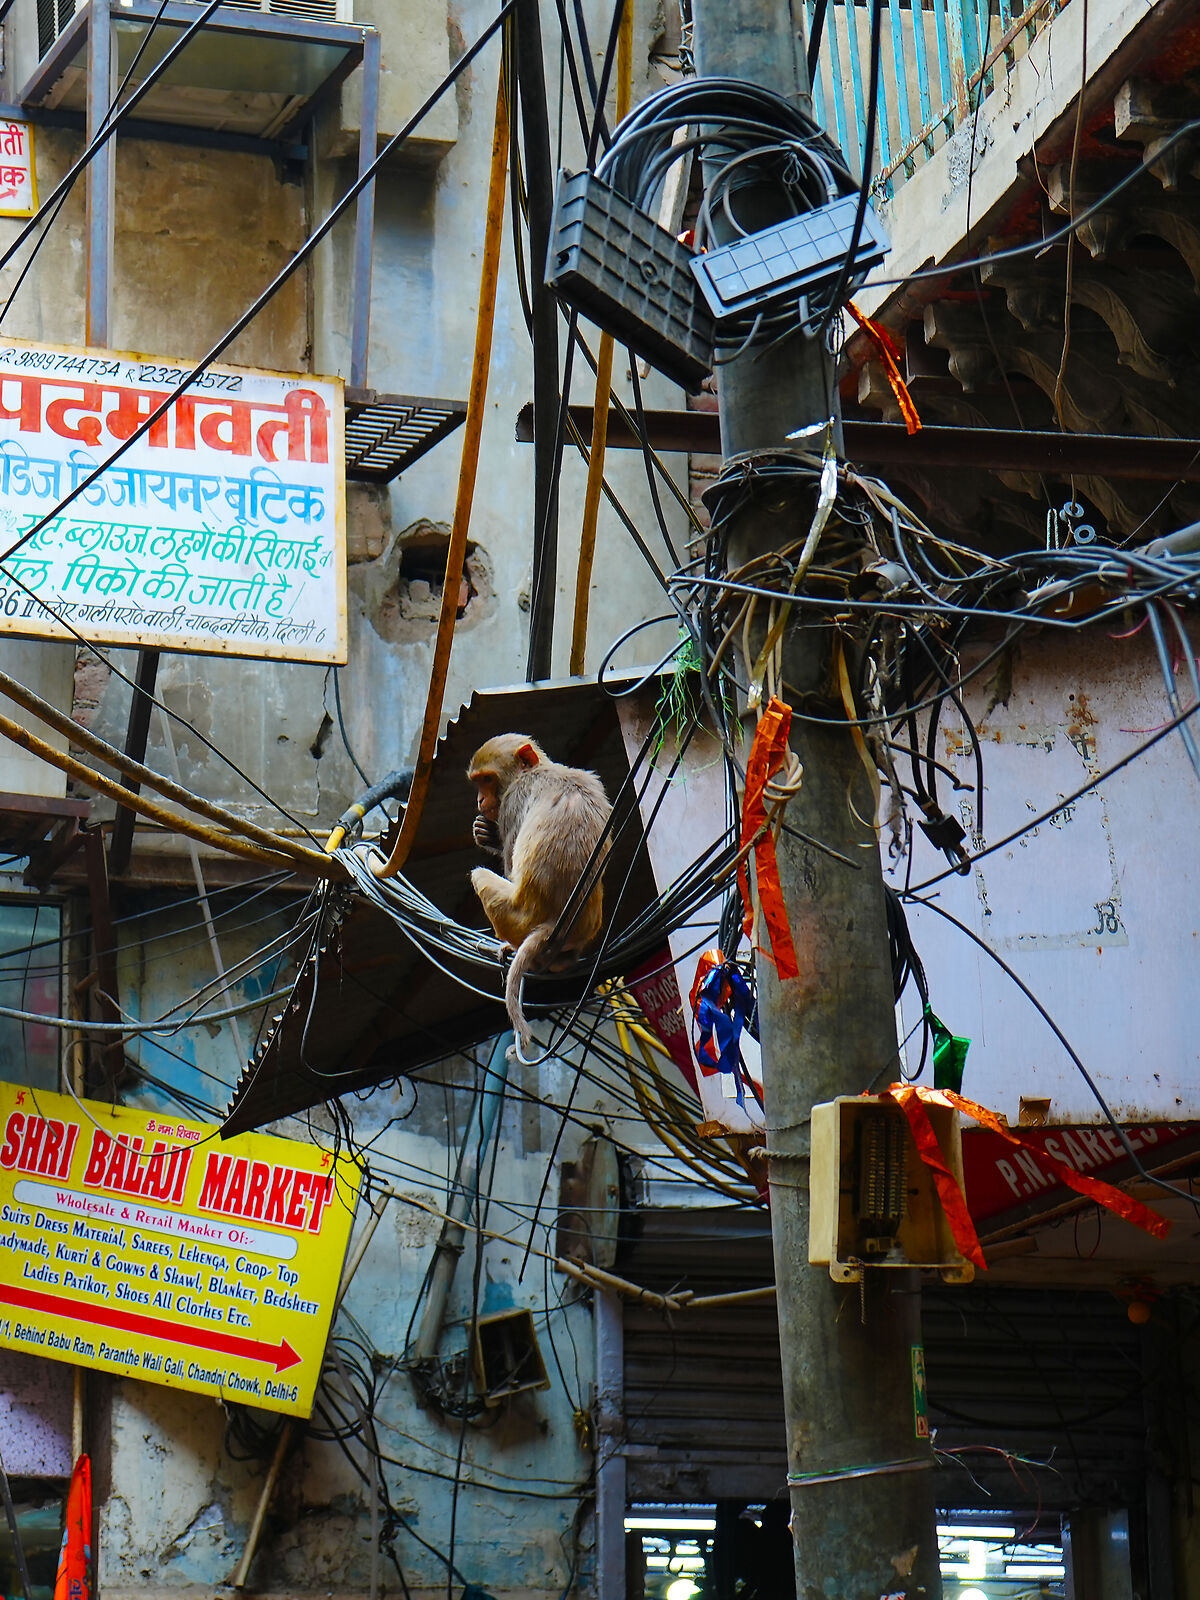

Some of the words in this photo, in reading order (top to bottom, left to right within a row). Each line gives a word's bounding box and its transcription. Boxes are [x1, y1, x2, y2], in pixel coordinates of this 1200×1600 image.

[212, 524, 248, 564] की
[143, 563, 193, 602] की
[189, 572, 270, 610] जाती
[0, 1111, 80, 1183] SHRI
[82, 1127, 194, 1208] BALAJI
[197, 1151, 336, 1236] MARKET
[995, 1149, 1057, 1198] P.N.
[120, 1207, 130, 1220] &
[91, 1250, 102, 1268] &
[149, 1263, 160, 1281] &
[13, 1323, 45, 1345] Behind
[47, 1330, 72, 1350] Babu
[72, 1336, 96, 1359] Ram,
[97, 1342, 140, 1366] Paranthe
[142, 1351, 162, 1371] Wali
[164, 1357, 185, 1380] Gali,
[187, 1363, 226, 1387] Chandni
[227, 1371, 261, 1398] Chowk,
[264, 1380, 298, 1402] Delhi-6
